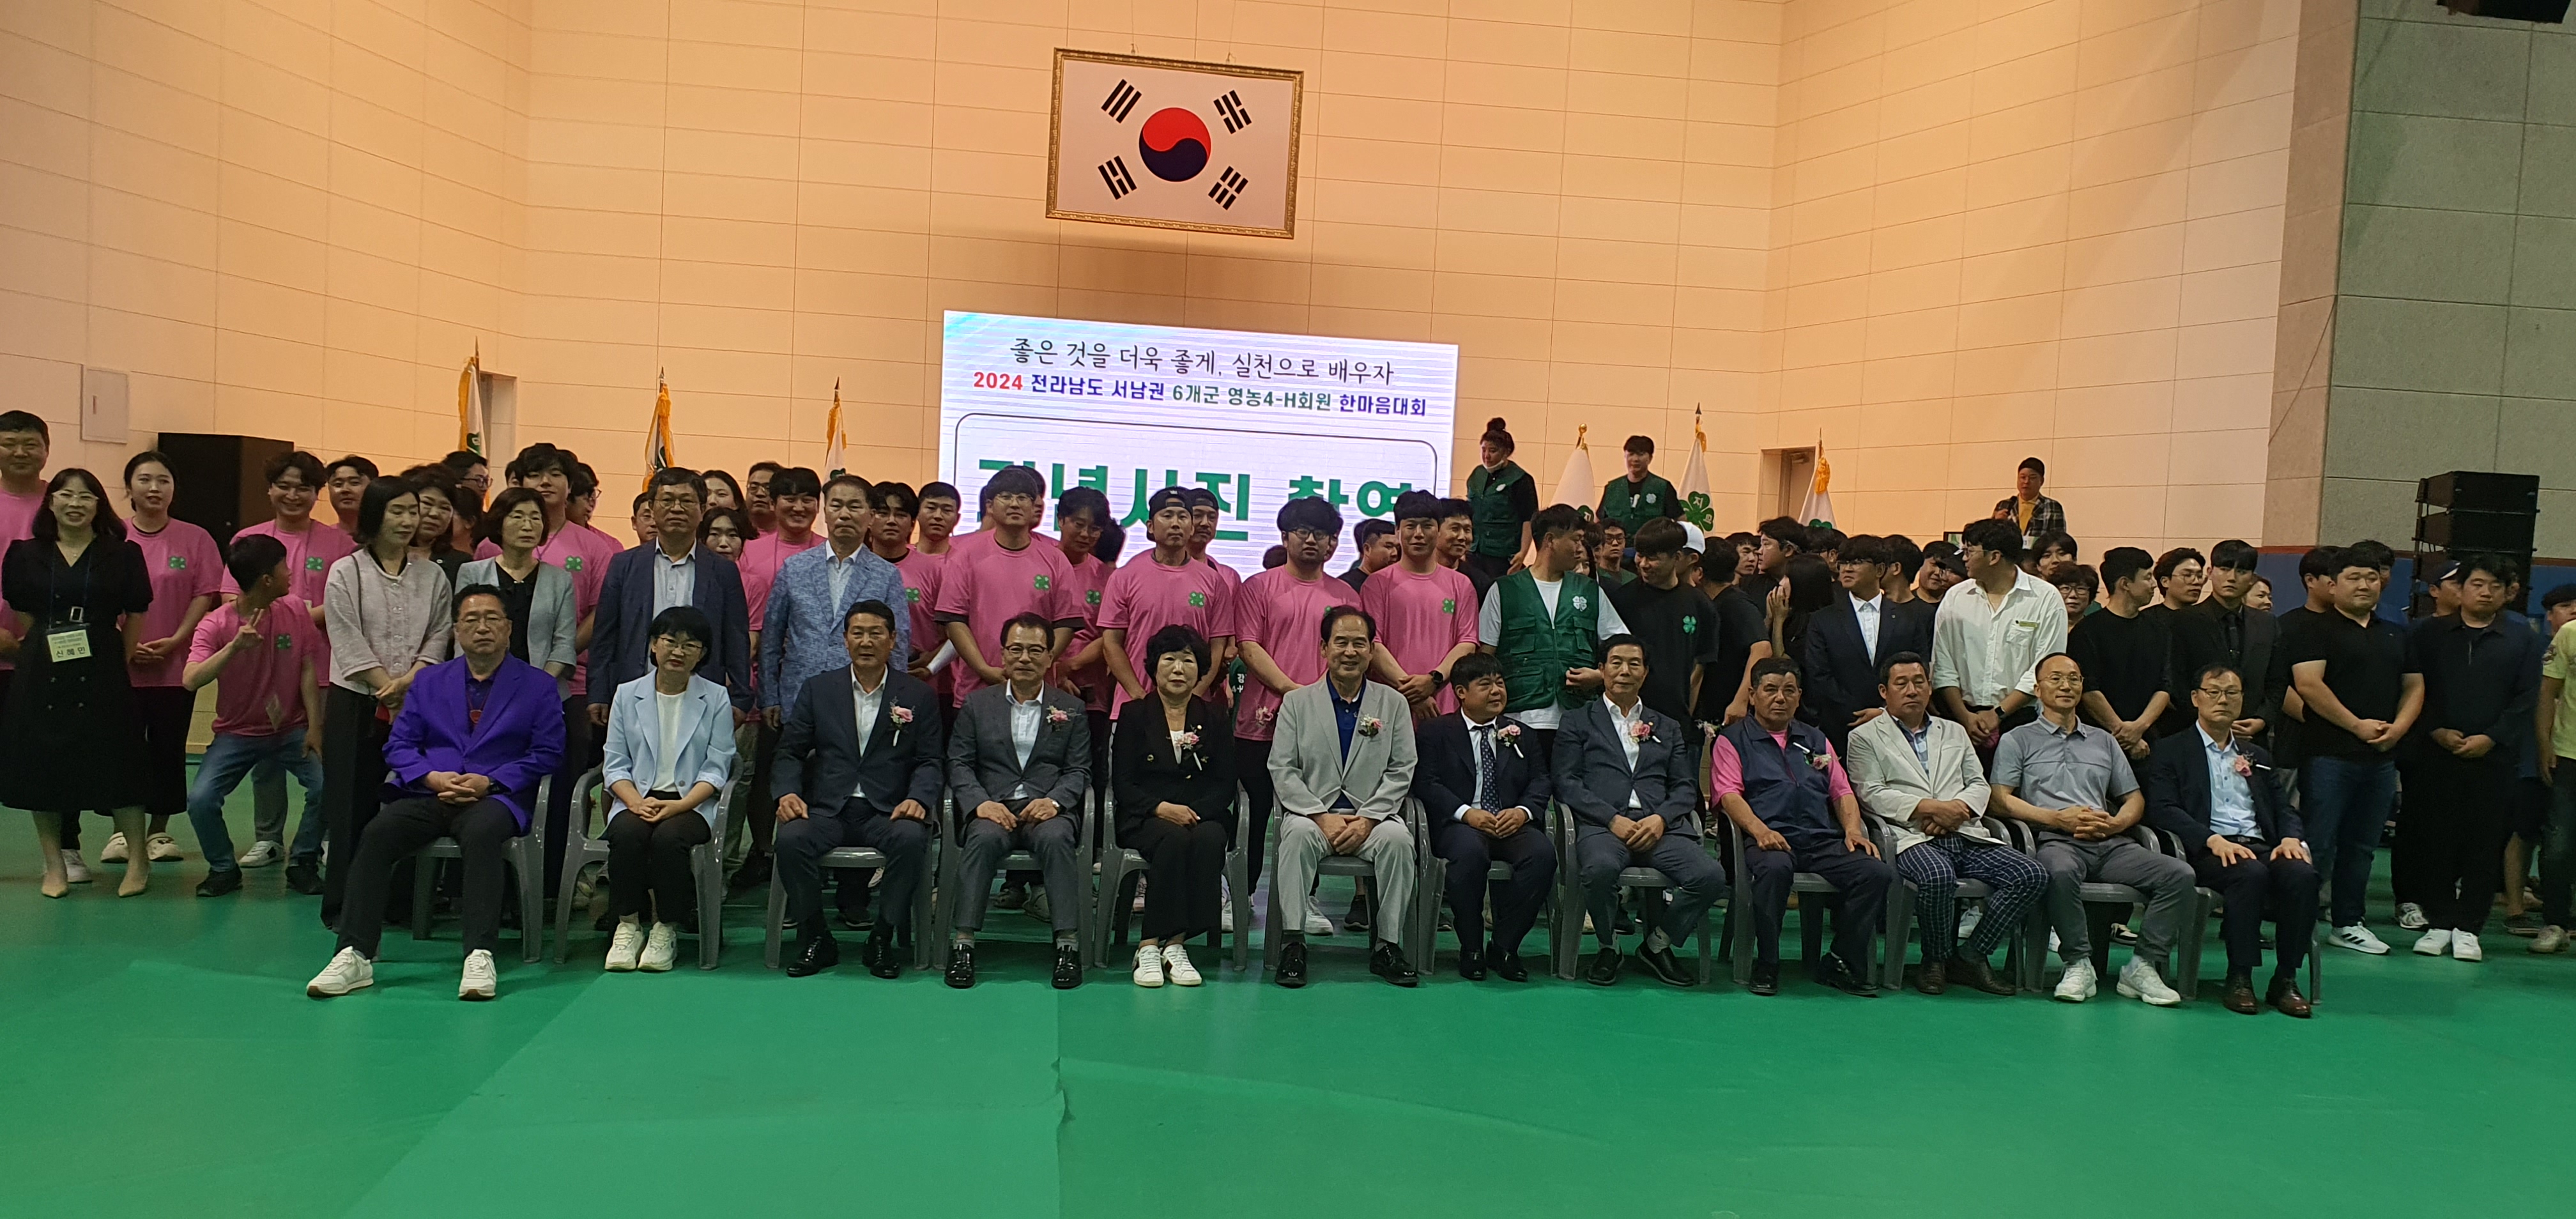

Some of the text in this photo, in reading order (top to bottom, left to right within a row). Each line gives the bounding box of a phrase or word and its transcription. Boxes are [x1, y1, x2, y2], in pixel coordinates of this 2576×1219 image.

[1010, 338, 1394, 386] 좋은 것을 더욱 좋게, 실천으로 배우자
[974, 372, 1426, 416] 2024 전라남도 서남권 6개군 영농4-H회원 한마음대회
